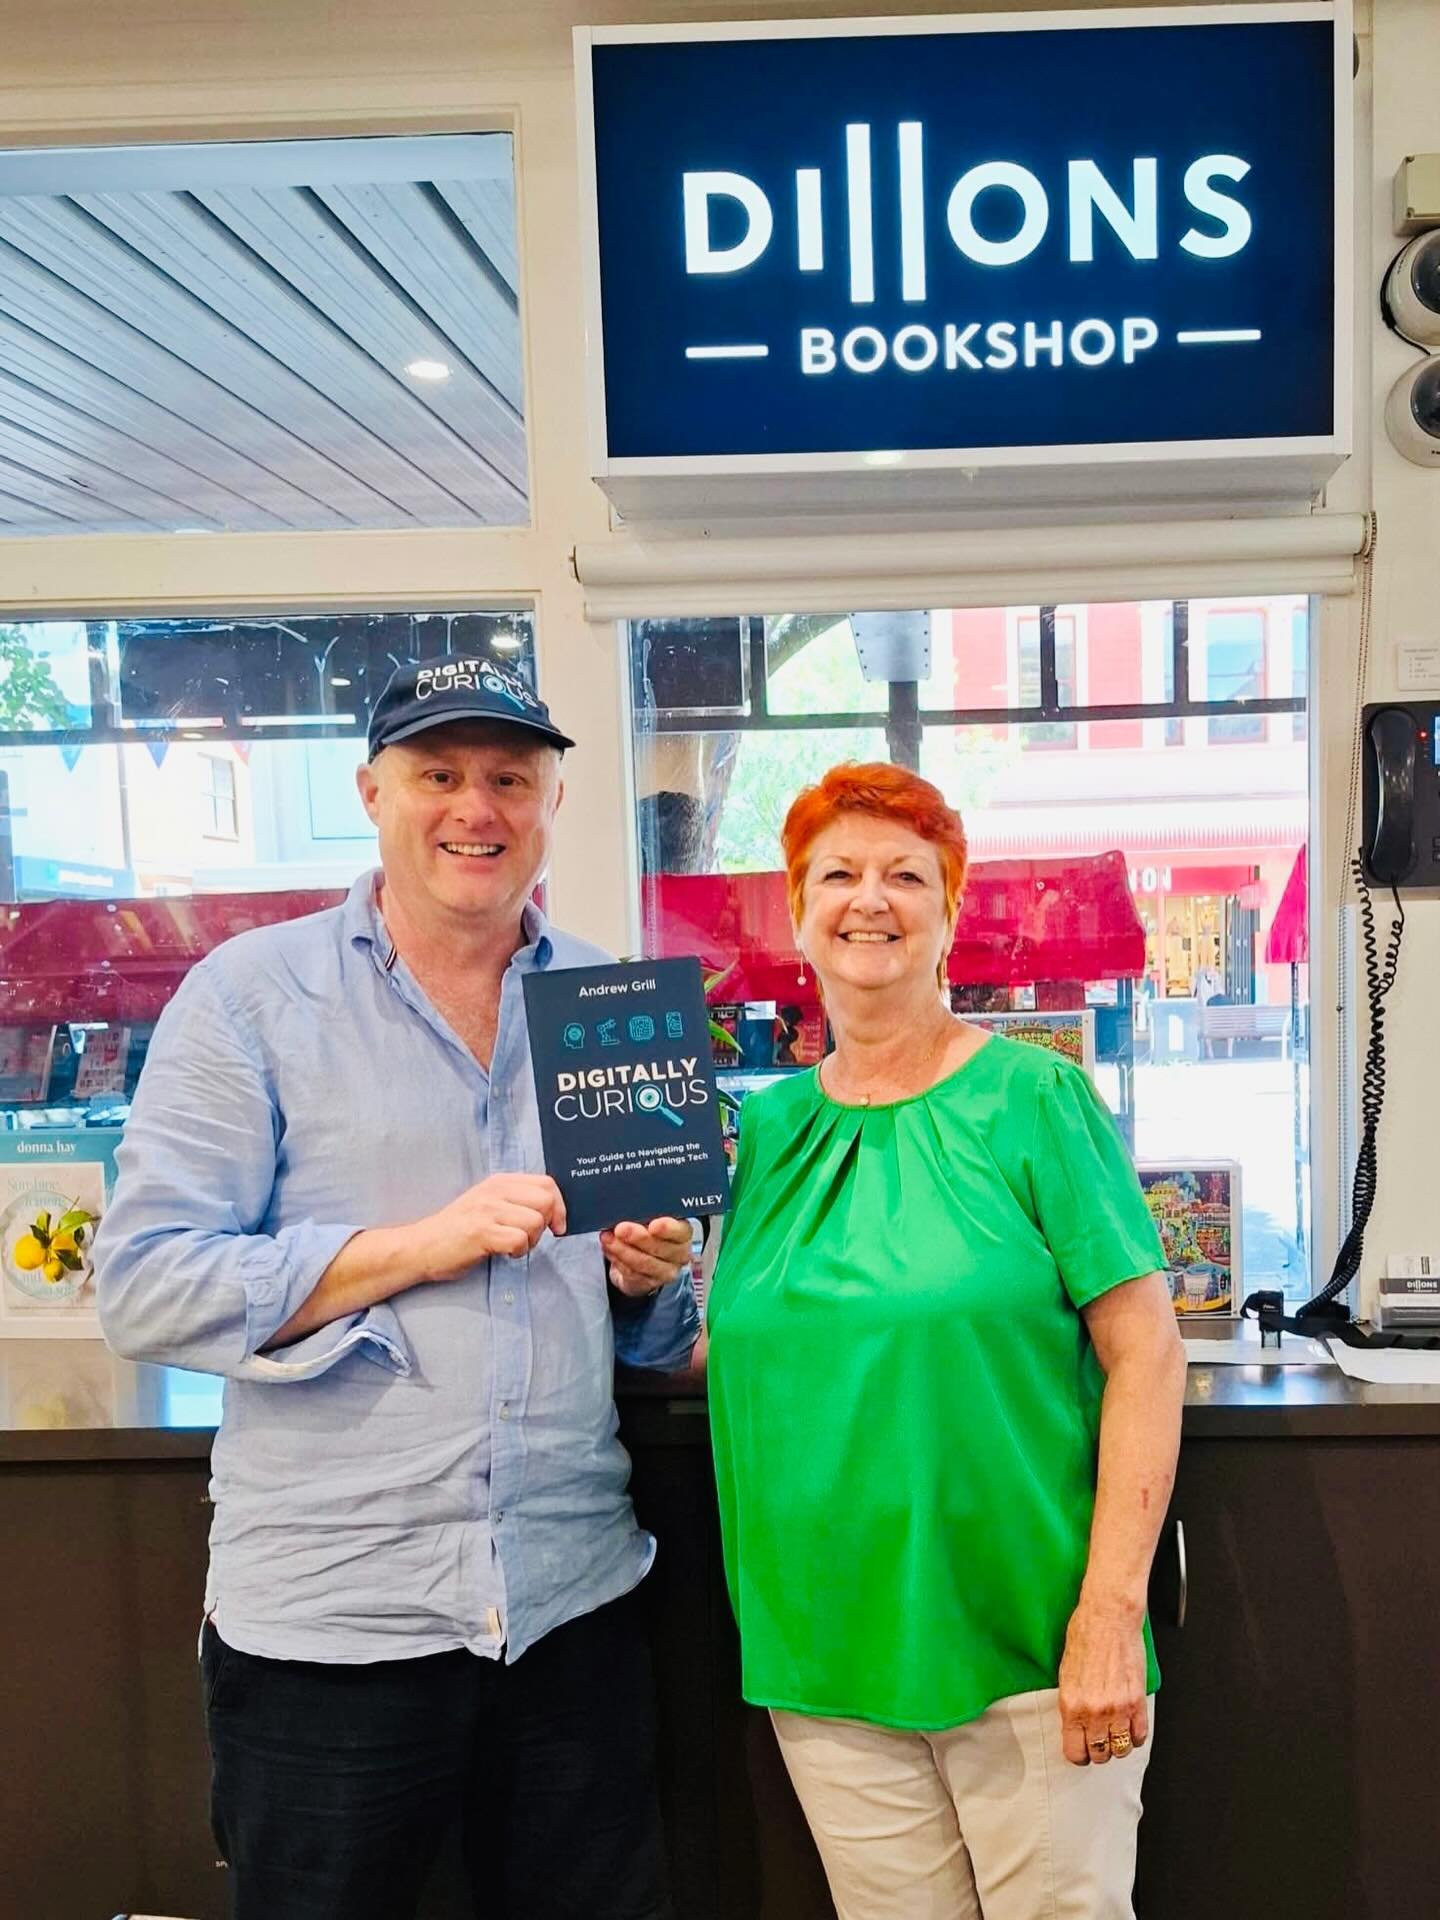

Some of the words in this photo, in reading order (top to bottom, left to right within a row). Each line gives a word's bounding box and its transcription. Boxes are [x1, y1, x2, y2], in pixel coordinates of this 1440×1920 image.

[799, 317, 1159, 376] BOOKSHOP
[417, 660, 523, 690] DIGITALLY
[415, 673, 538, 708] CURIOUS
[578, 984, 628, 998] Andrew
[631, 978, 656, 991] Grill
[557, 1057, 697, 1092] DIGITALLY
[554, 1079, 708, 1121] CURIOUS
[16, 1140, 53, 1153] donna
[56, 1139, 77, 1156] hay
[576, 1157, 597, 1165] Your
[599, 1152, 625, 1163] Guide
[638, 1144, 684, 1157] Navigating
[570, 1167, 600, 1178] Future
[602, 1165, 612, 1173] of
[625, 1161, 642, 1170] and
[644, 1159, 656, 1167] All
[658, 1155, 686, 1166] Things
[687, 1152, 709, 1161] Tech
[681, 1194, 722, 1208] WILEY
